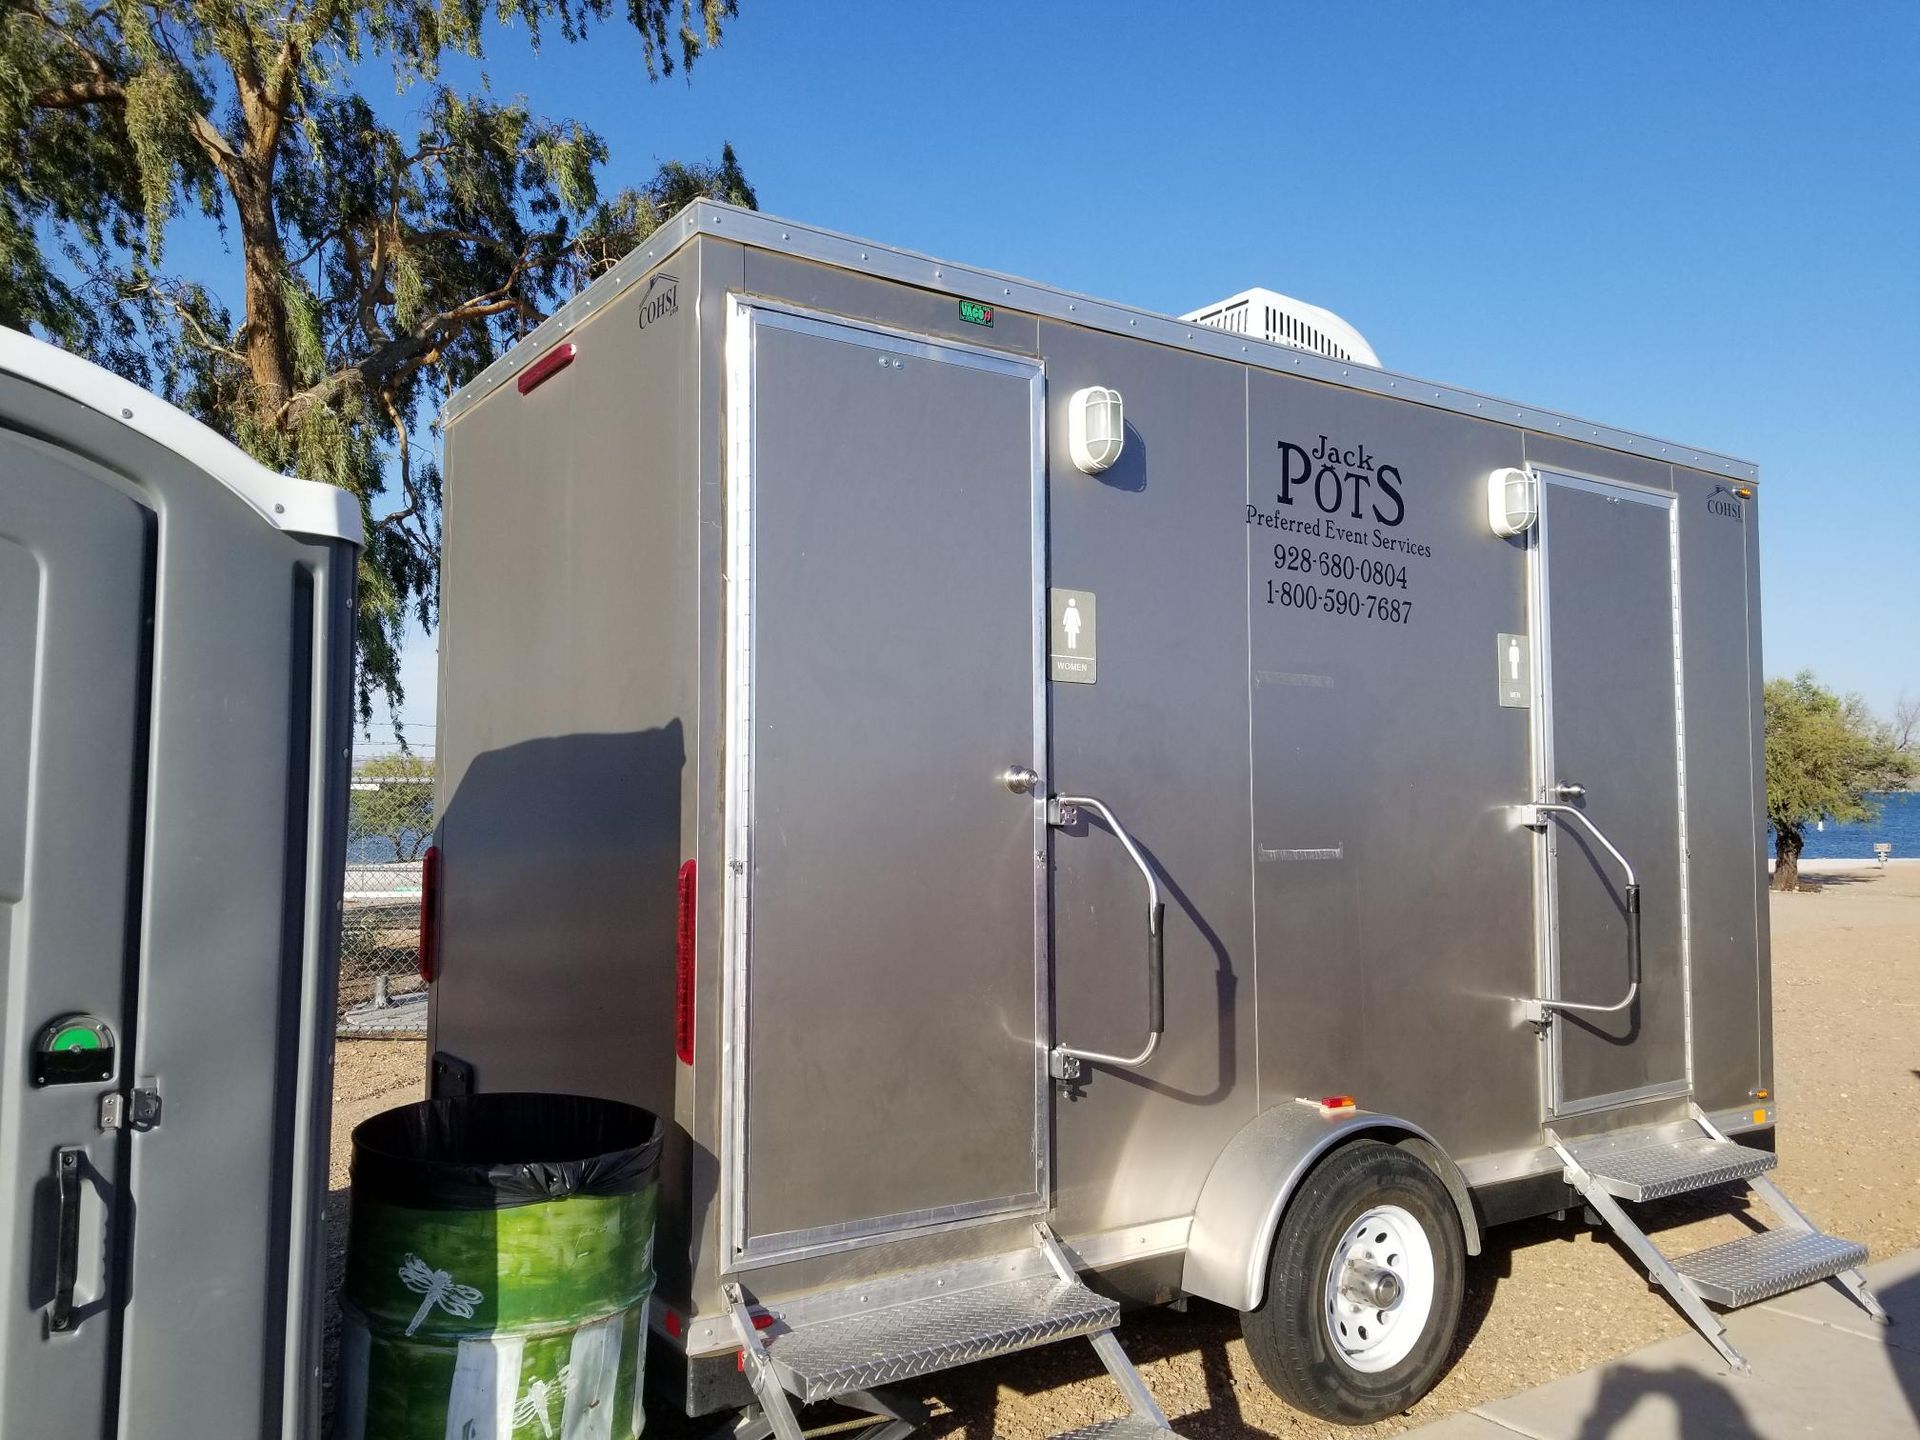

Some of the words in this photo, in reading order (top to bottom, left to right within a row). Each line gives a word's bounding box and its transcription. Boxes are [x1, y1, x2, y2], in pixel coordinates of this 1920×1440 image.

[639, 284, 678, 330] COHSI
[1311, 434, 1374, 472] Jack
[1277, 440, 1405, 527] POTS
[1246, 504, 1321, 537] Preferred
[1325, 519, 1369, 546] Event
[1371, 528, 1432, 558] Services
[1707, 499, 1741, 519] COHSI
[1273, 543, 1408, 590] 928-680-0804
[1266, 579, 1413, 625] 1-800-590-7687
[1057, 661, 1088, 672] WOMEN
